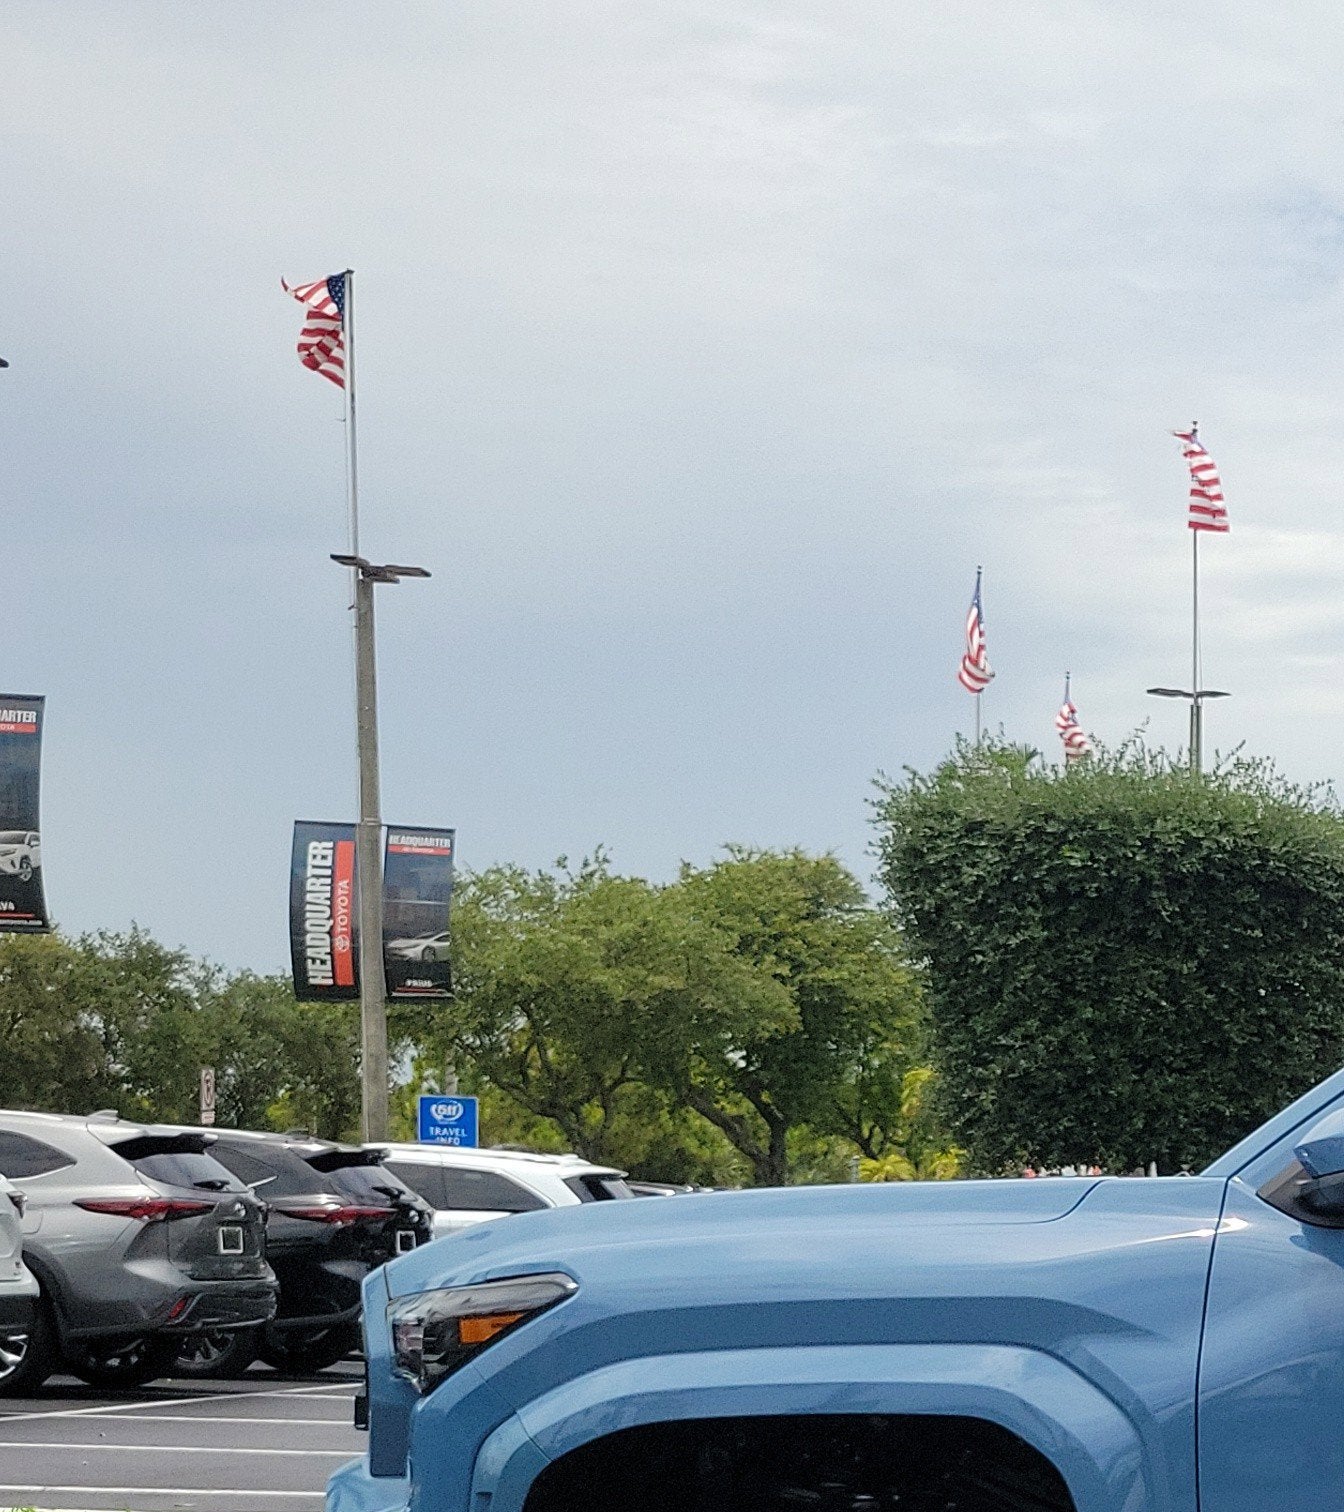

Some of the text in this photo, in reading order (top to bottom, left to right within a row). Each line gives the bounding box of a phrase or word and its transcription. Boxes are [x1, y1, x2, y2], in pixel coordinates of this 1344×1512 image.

[0, 709, 37, 723] ARTER
[305, 840, 334, 985] HEADQUARTER
[337, 879, 350, 933] TOYOTA
[429, 1126, 467, 1138] TRAVEL
